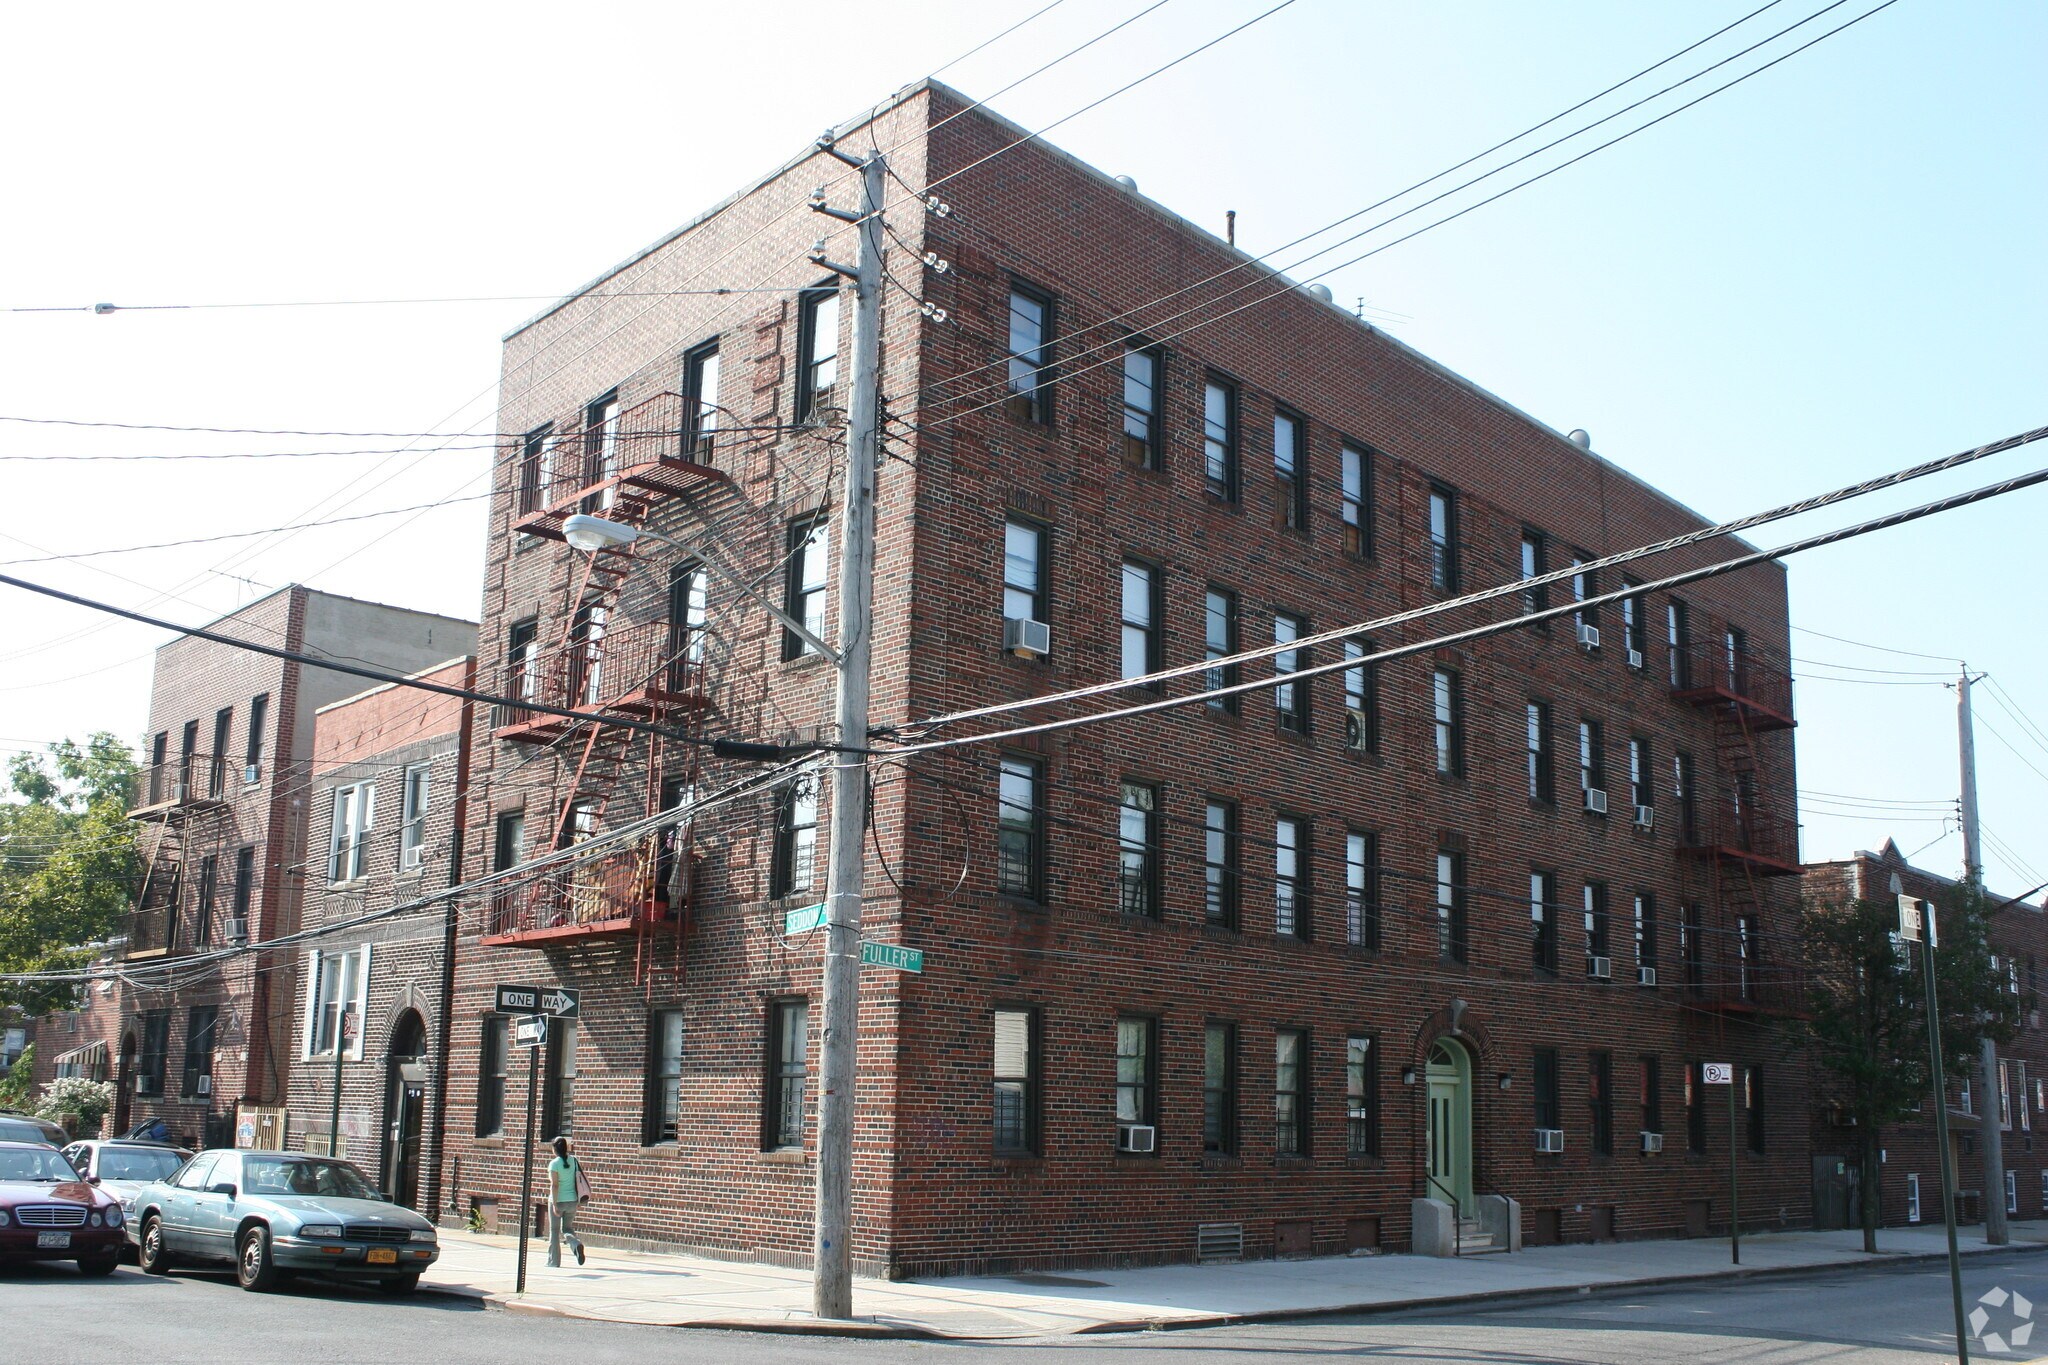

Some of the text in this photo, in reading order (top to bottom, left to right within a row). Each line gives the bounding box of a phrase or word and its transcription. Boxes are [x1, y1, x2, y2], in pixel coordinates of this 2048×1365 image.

[787, 909, 819, 932] SEDDON
[1906, 910, 1920, 928] ONE
[862, 943, 919, 968] FULLER ST
[508, 993, 567, 1008] ONE WAY
